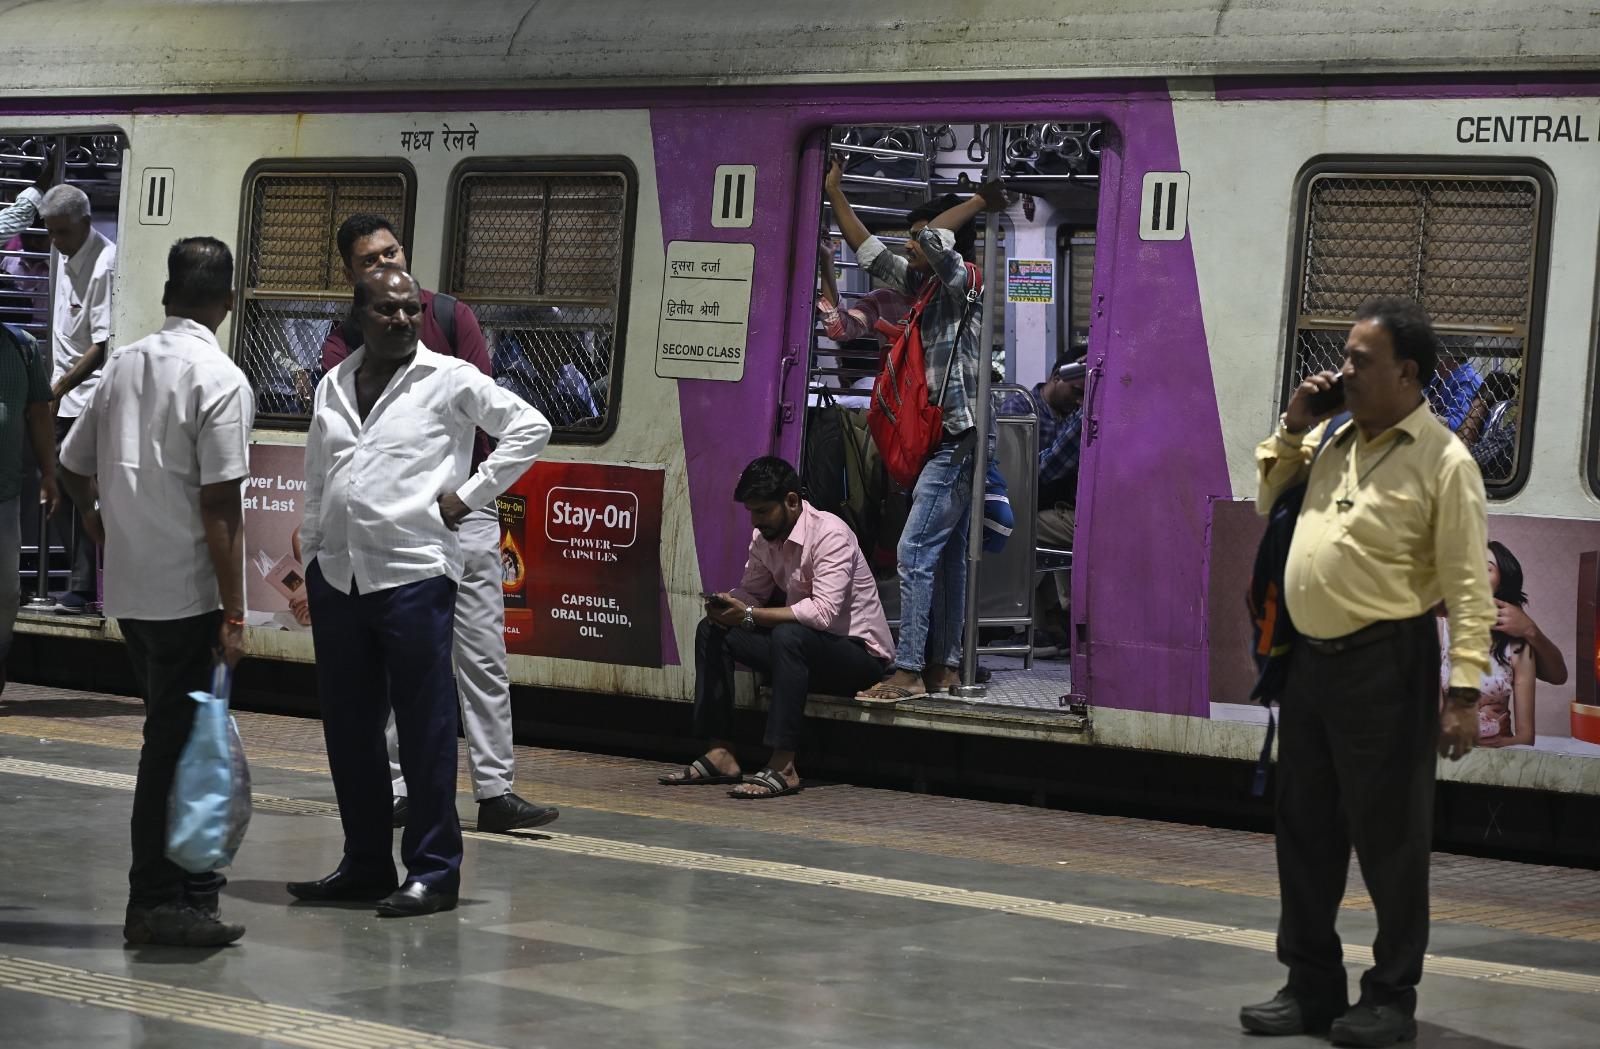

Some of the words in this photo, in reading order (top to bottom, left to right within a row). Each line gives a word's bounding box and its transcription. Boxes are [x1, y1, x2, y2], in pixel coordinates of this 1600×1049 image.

[401, 131, 434, 152] मध्य
[442, 122, 479, 152] रेलवे
[1456, 115, 1589, 143] CENTRAL
[671, 260, 695, 275] दूसरा
[701, 258, 720, 273] दर्जा
[667, 299, 694, 316] द्वितीय
[700, 301, 720, 316] श्रेणी
[662, 343, 704, 356] SECOND
[706, 346, 741, 359] CLASS
[243, 495, 259, 510] at
[262, 495, 295, 512] Last
[552, 500, 631, 533] Stay-On
[570, 537, 611, 550] POWER
[562, 548, 618, 562] CAPSULES
[561, 593, 620, 611] CAPSULE,
[551, 608, 583, 621] ORAL
[586, 611, 632, 628] LIQUID,
[579, 625, 604, 638] OIL.
